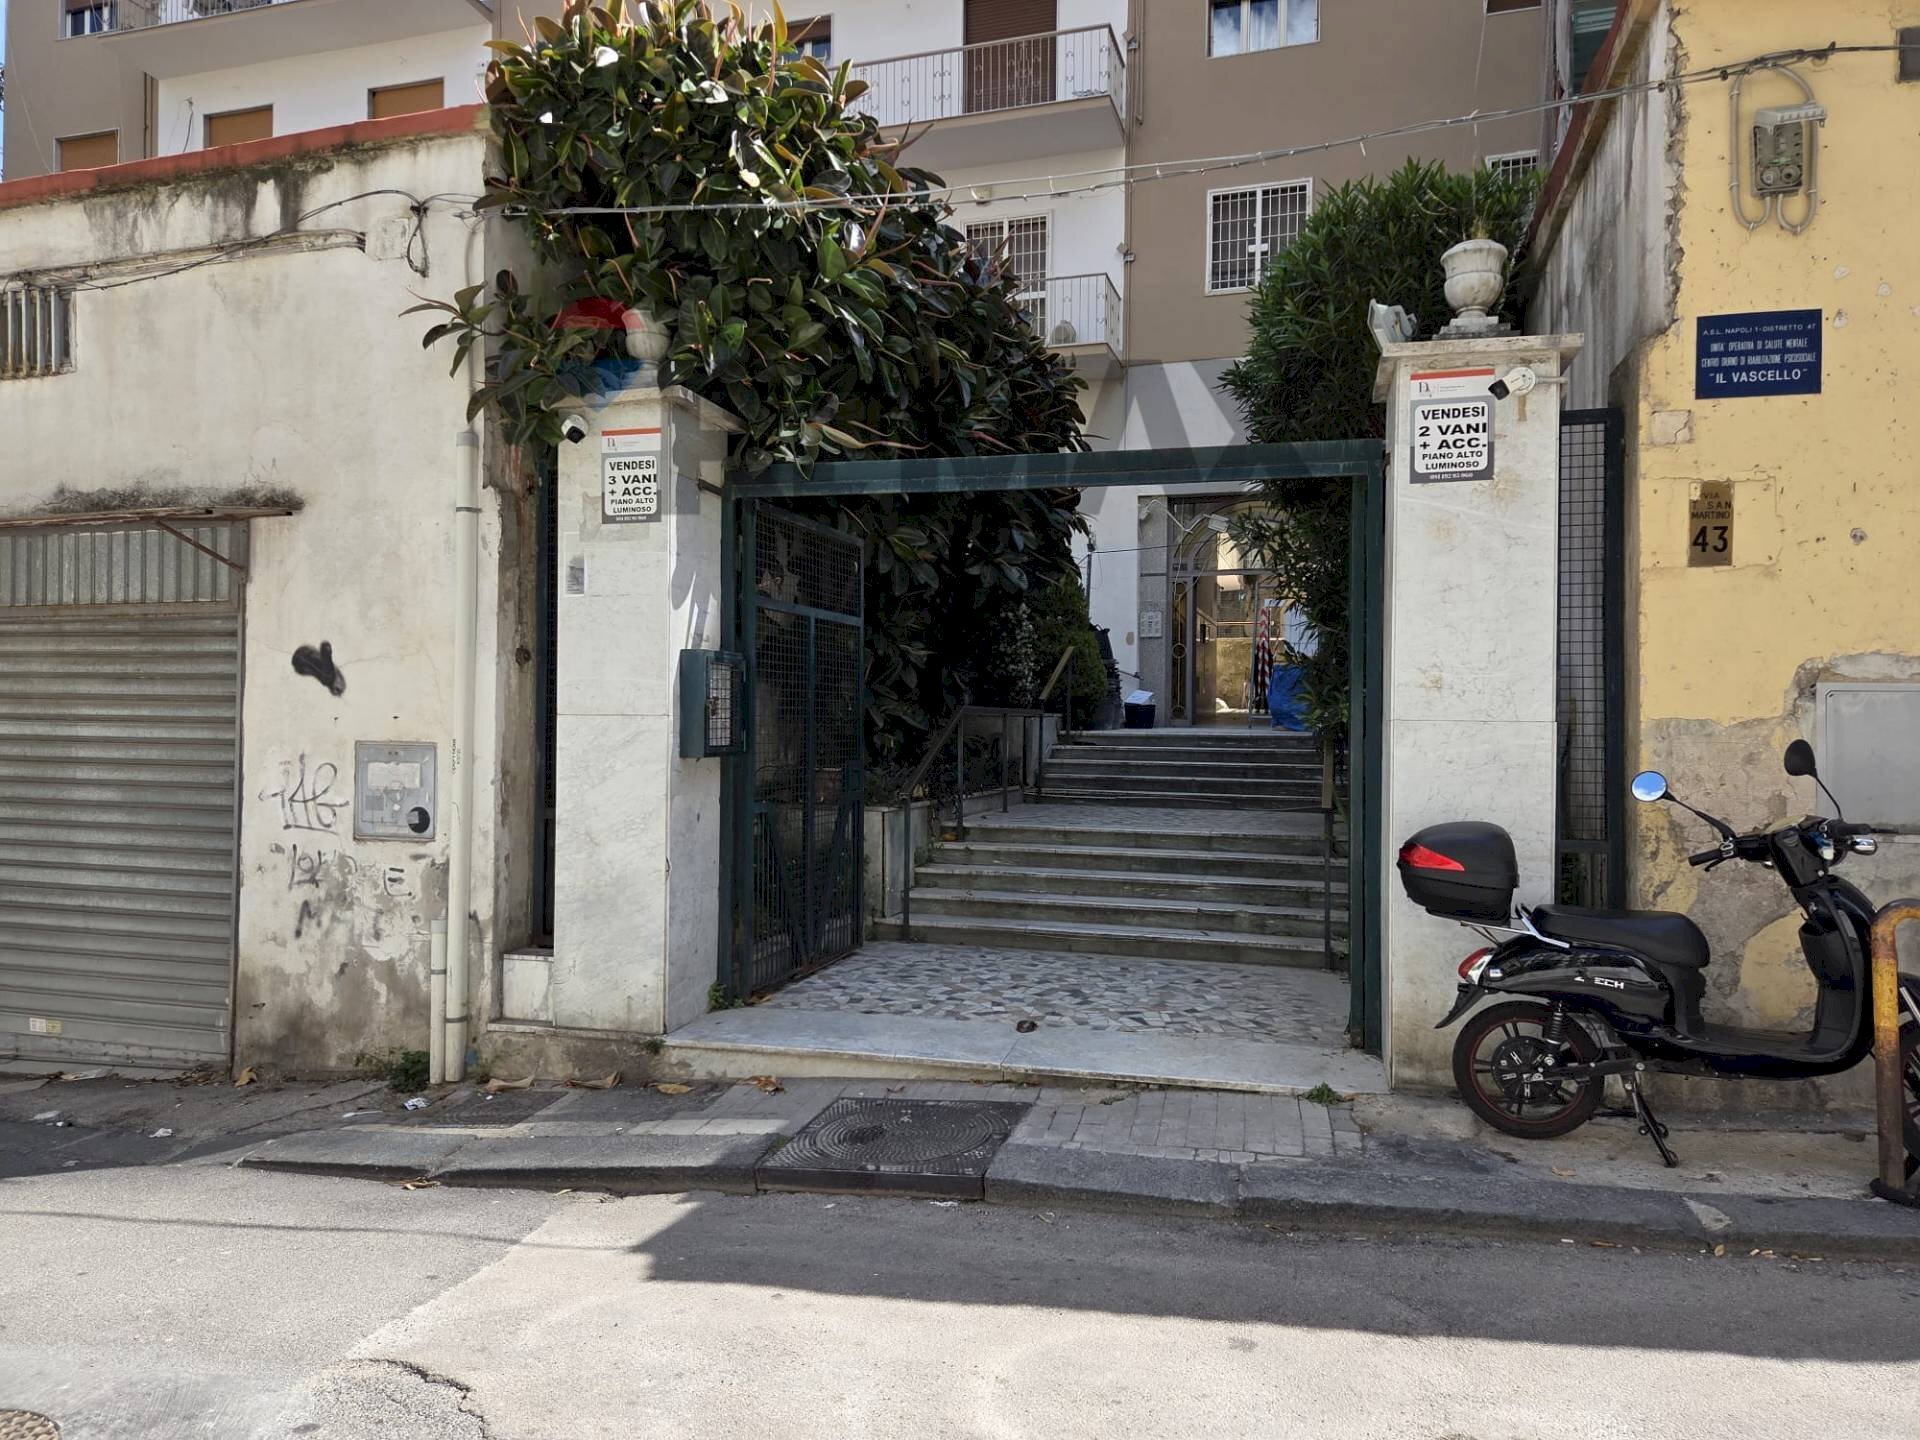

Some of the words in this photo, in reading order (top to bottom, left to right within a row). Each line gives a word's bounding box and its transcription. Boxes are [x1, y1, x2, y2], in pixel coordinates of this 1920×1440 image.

[1764, 339, 1783, 349] SALUTE
[1786, 338, 1808, 348] MENTALE
[1421, 406, 1485, 420] VENDESI
[1419, 426, 1430, 437] 2
[1437, 423, 1487, 436] VANI
[1437, 438, 1487, 450] ACC.
[1422, 452, 1454, 461] PIANO
[1456, 450, 1483, 459] ALTO
[609, 460, 655, 471] VENDESI
[1425, 461, 1479, 470] LUMINOSO
[608, 475, 617, 485] 3
[621, 474, 657, 484] VANI
[621, 486, 657, 497] ACC.
[1706, 500, 1732, 510] SAN
[1691, 510, 1731, 520] MARTINO
[1692, 525, 1729, 553] 43
